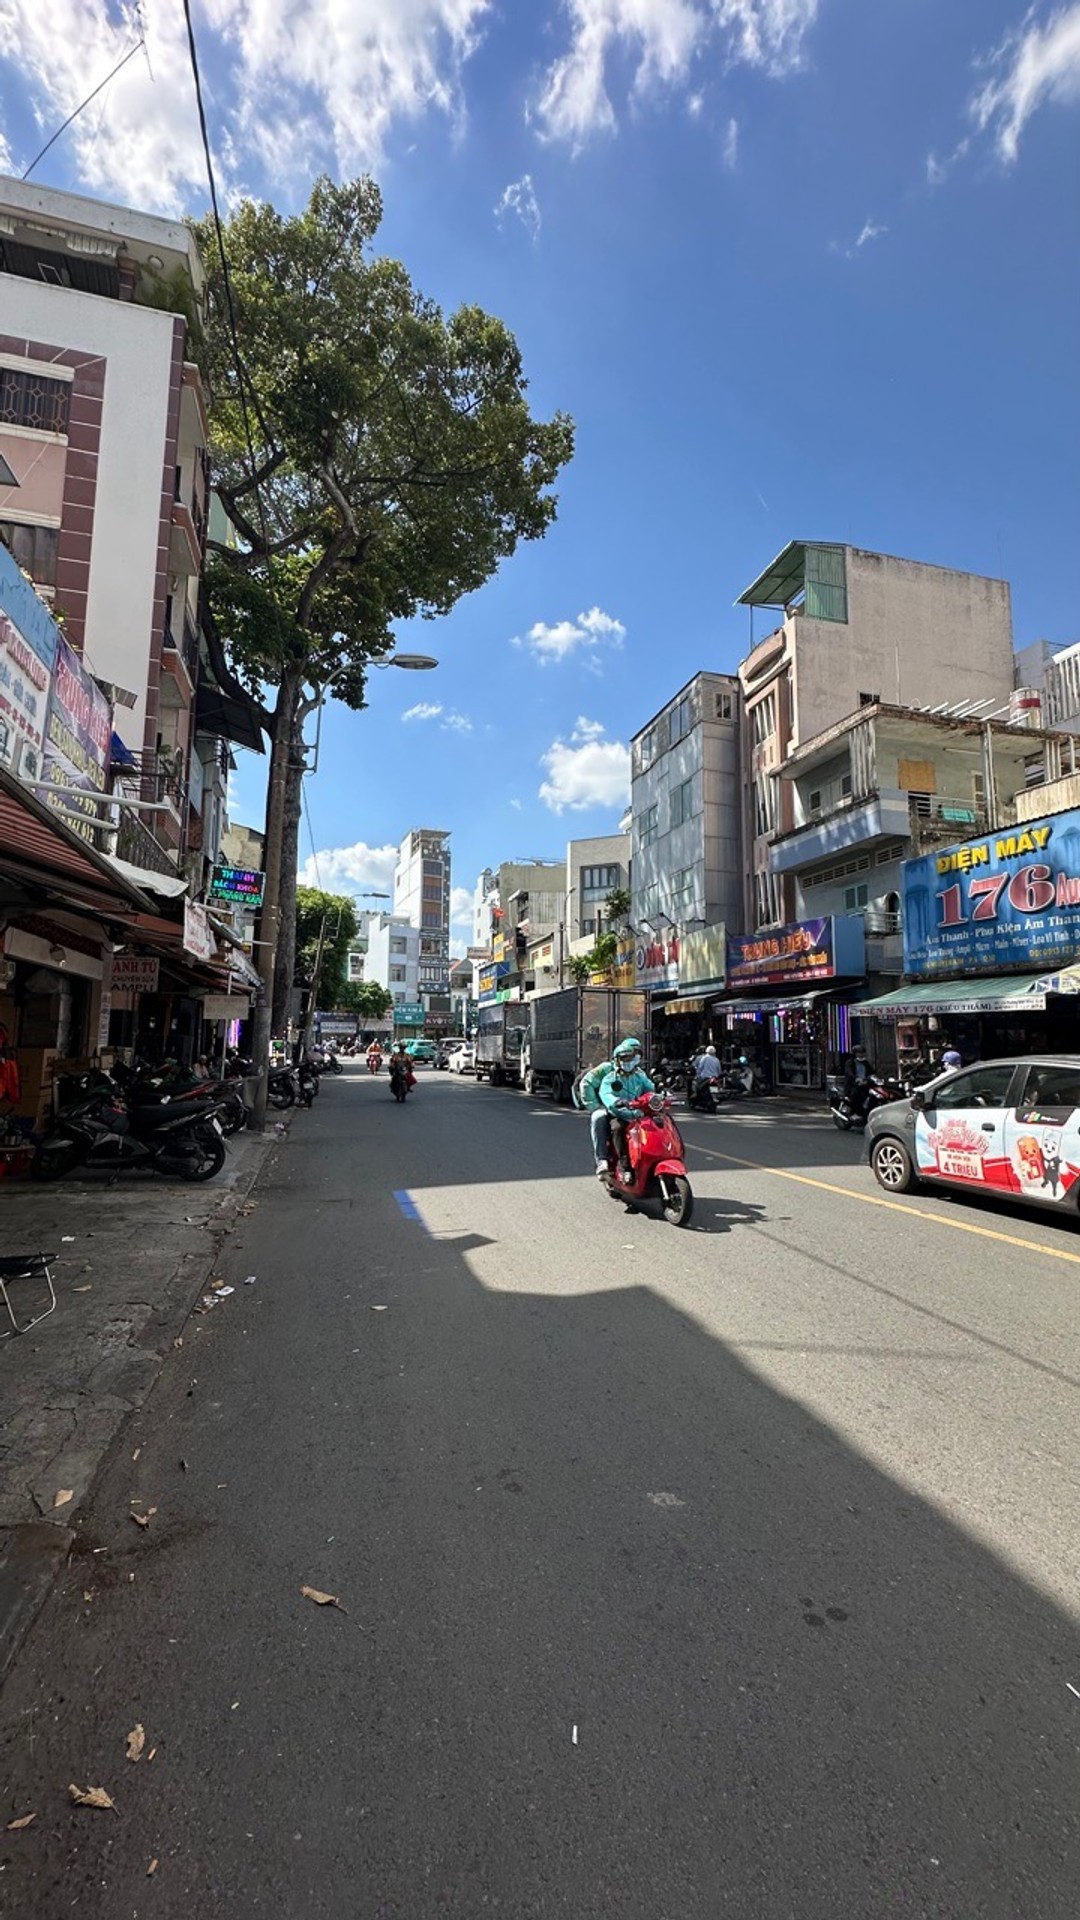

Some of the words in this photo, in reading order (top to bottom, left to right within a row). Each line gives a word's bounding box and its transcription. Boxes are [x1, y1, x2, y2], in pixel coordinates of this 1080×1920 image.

[936, 846, 988, 873] ĐIỆN
[996, 827, 1050, 858] MÁY
[936, 864, 1055, 927] 176
[741, 938, 780, 961] TRUNG
[113, 961, 138, 973] ANH
[914, 1004, 933, 1013] 176
[943, 1161, 951, 1172] 4
